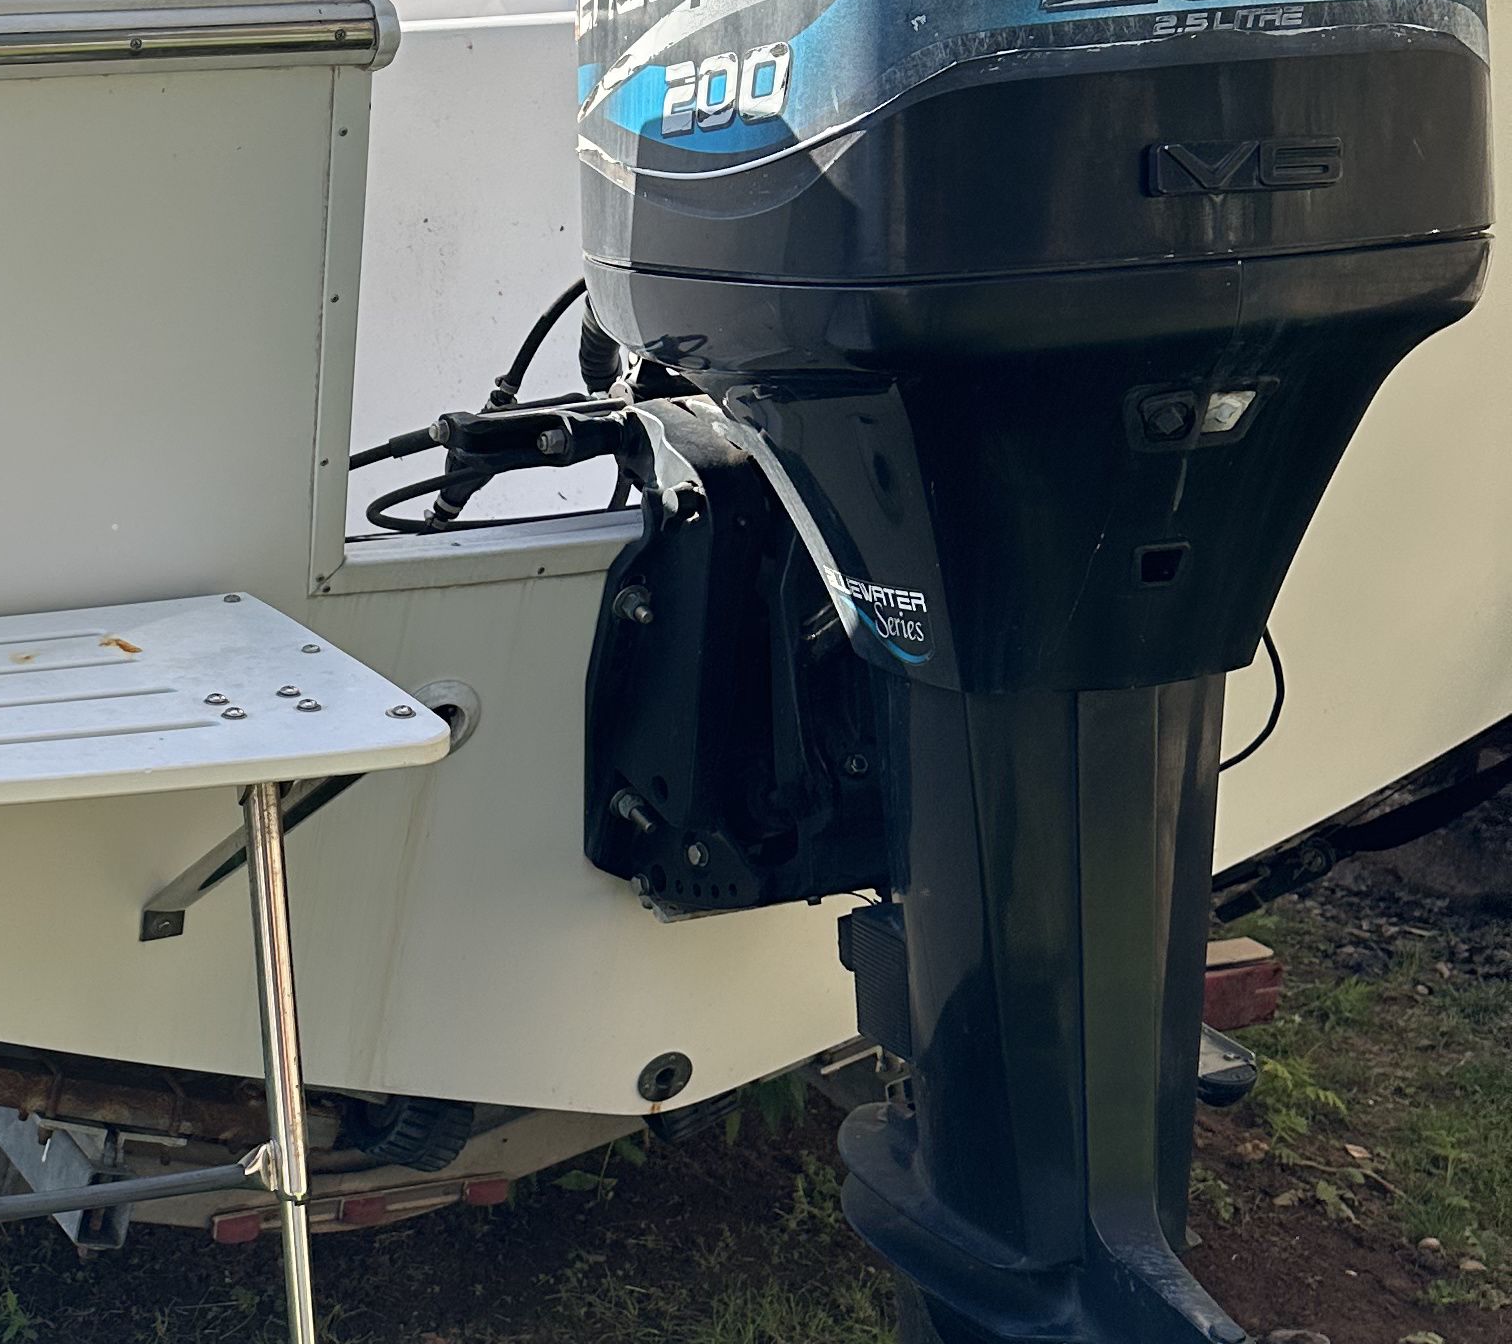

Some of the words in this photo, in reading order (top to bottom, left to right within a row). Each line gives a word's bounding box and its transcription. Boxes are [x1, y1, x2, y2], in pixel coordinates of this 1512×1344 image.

[1153, 12, 1208, 36] 2.5
[1213, 6, 1304, 31] LITRE
[661, 41, 792, 139] 200
[1164, 137, 1343, 190] V6
[874, 602, 925, 642] Series
